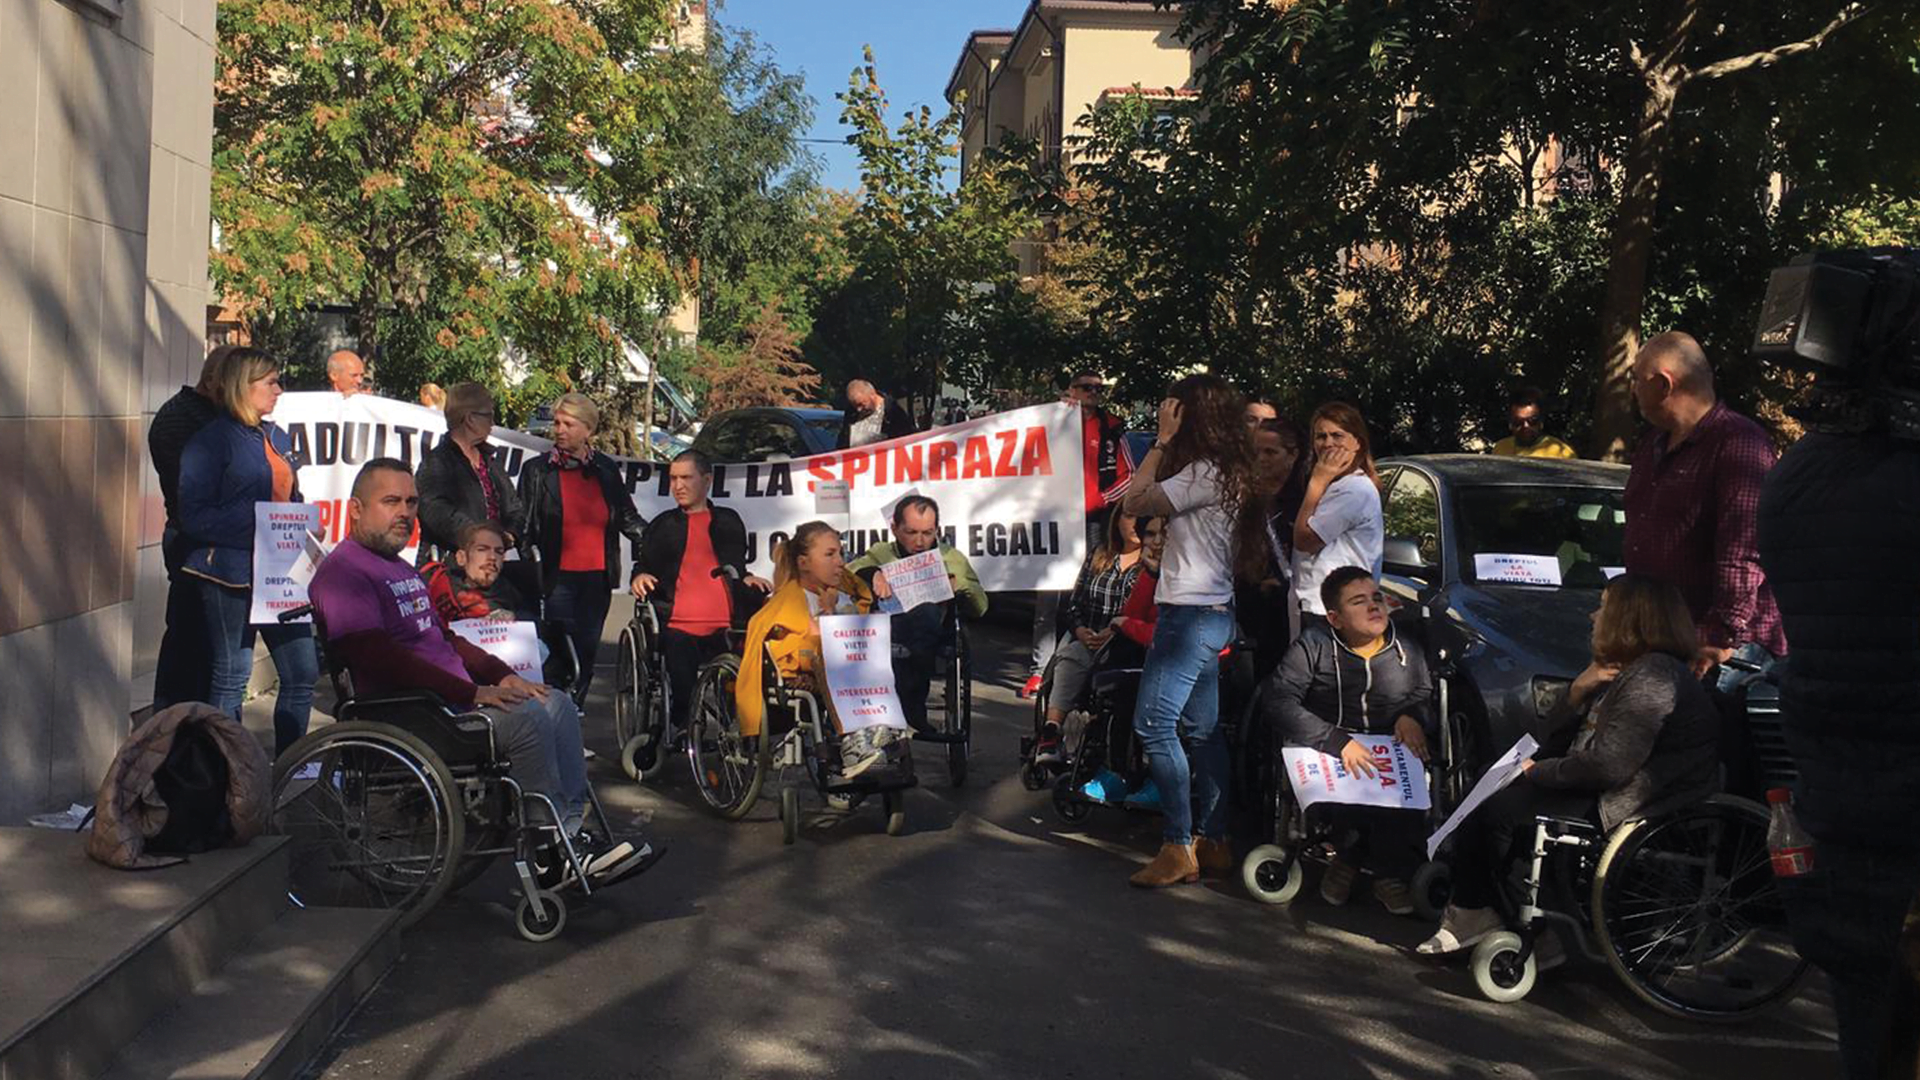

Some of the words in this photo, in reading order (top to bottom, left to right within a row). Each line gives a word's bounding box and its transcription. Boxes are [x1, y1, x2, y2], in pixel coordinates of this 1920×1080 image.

[745, 463, 793, 498] LA
[808, 426, 1053, 493] SPINRAZA
[268, 513, 309, 521] SPINRAZA
[283, 532, 294, 540] LA
[968, 521, 1060, 557] EGALI
[283, 589, 293, 598] LA
[833, 629, 877, 638] CALITATEA
[846, 653, 867, 661] MELE
[1307, 763, 1320, 775] DE
